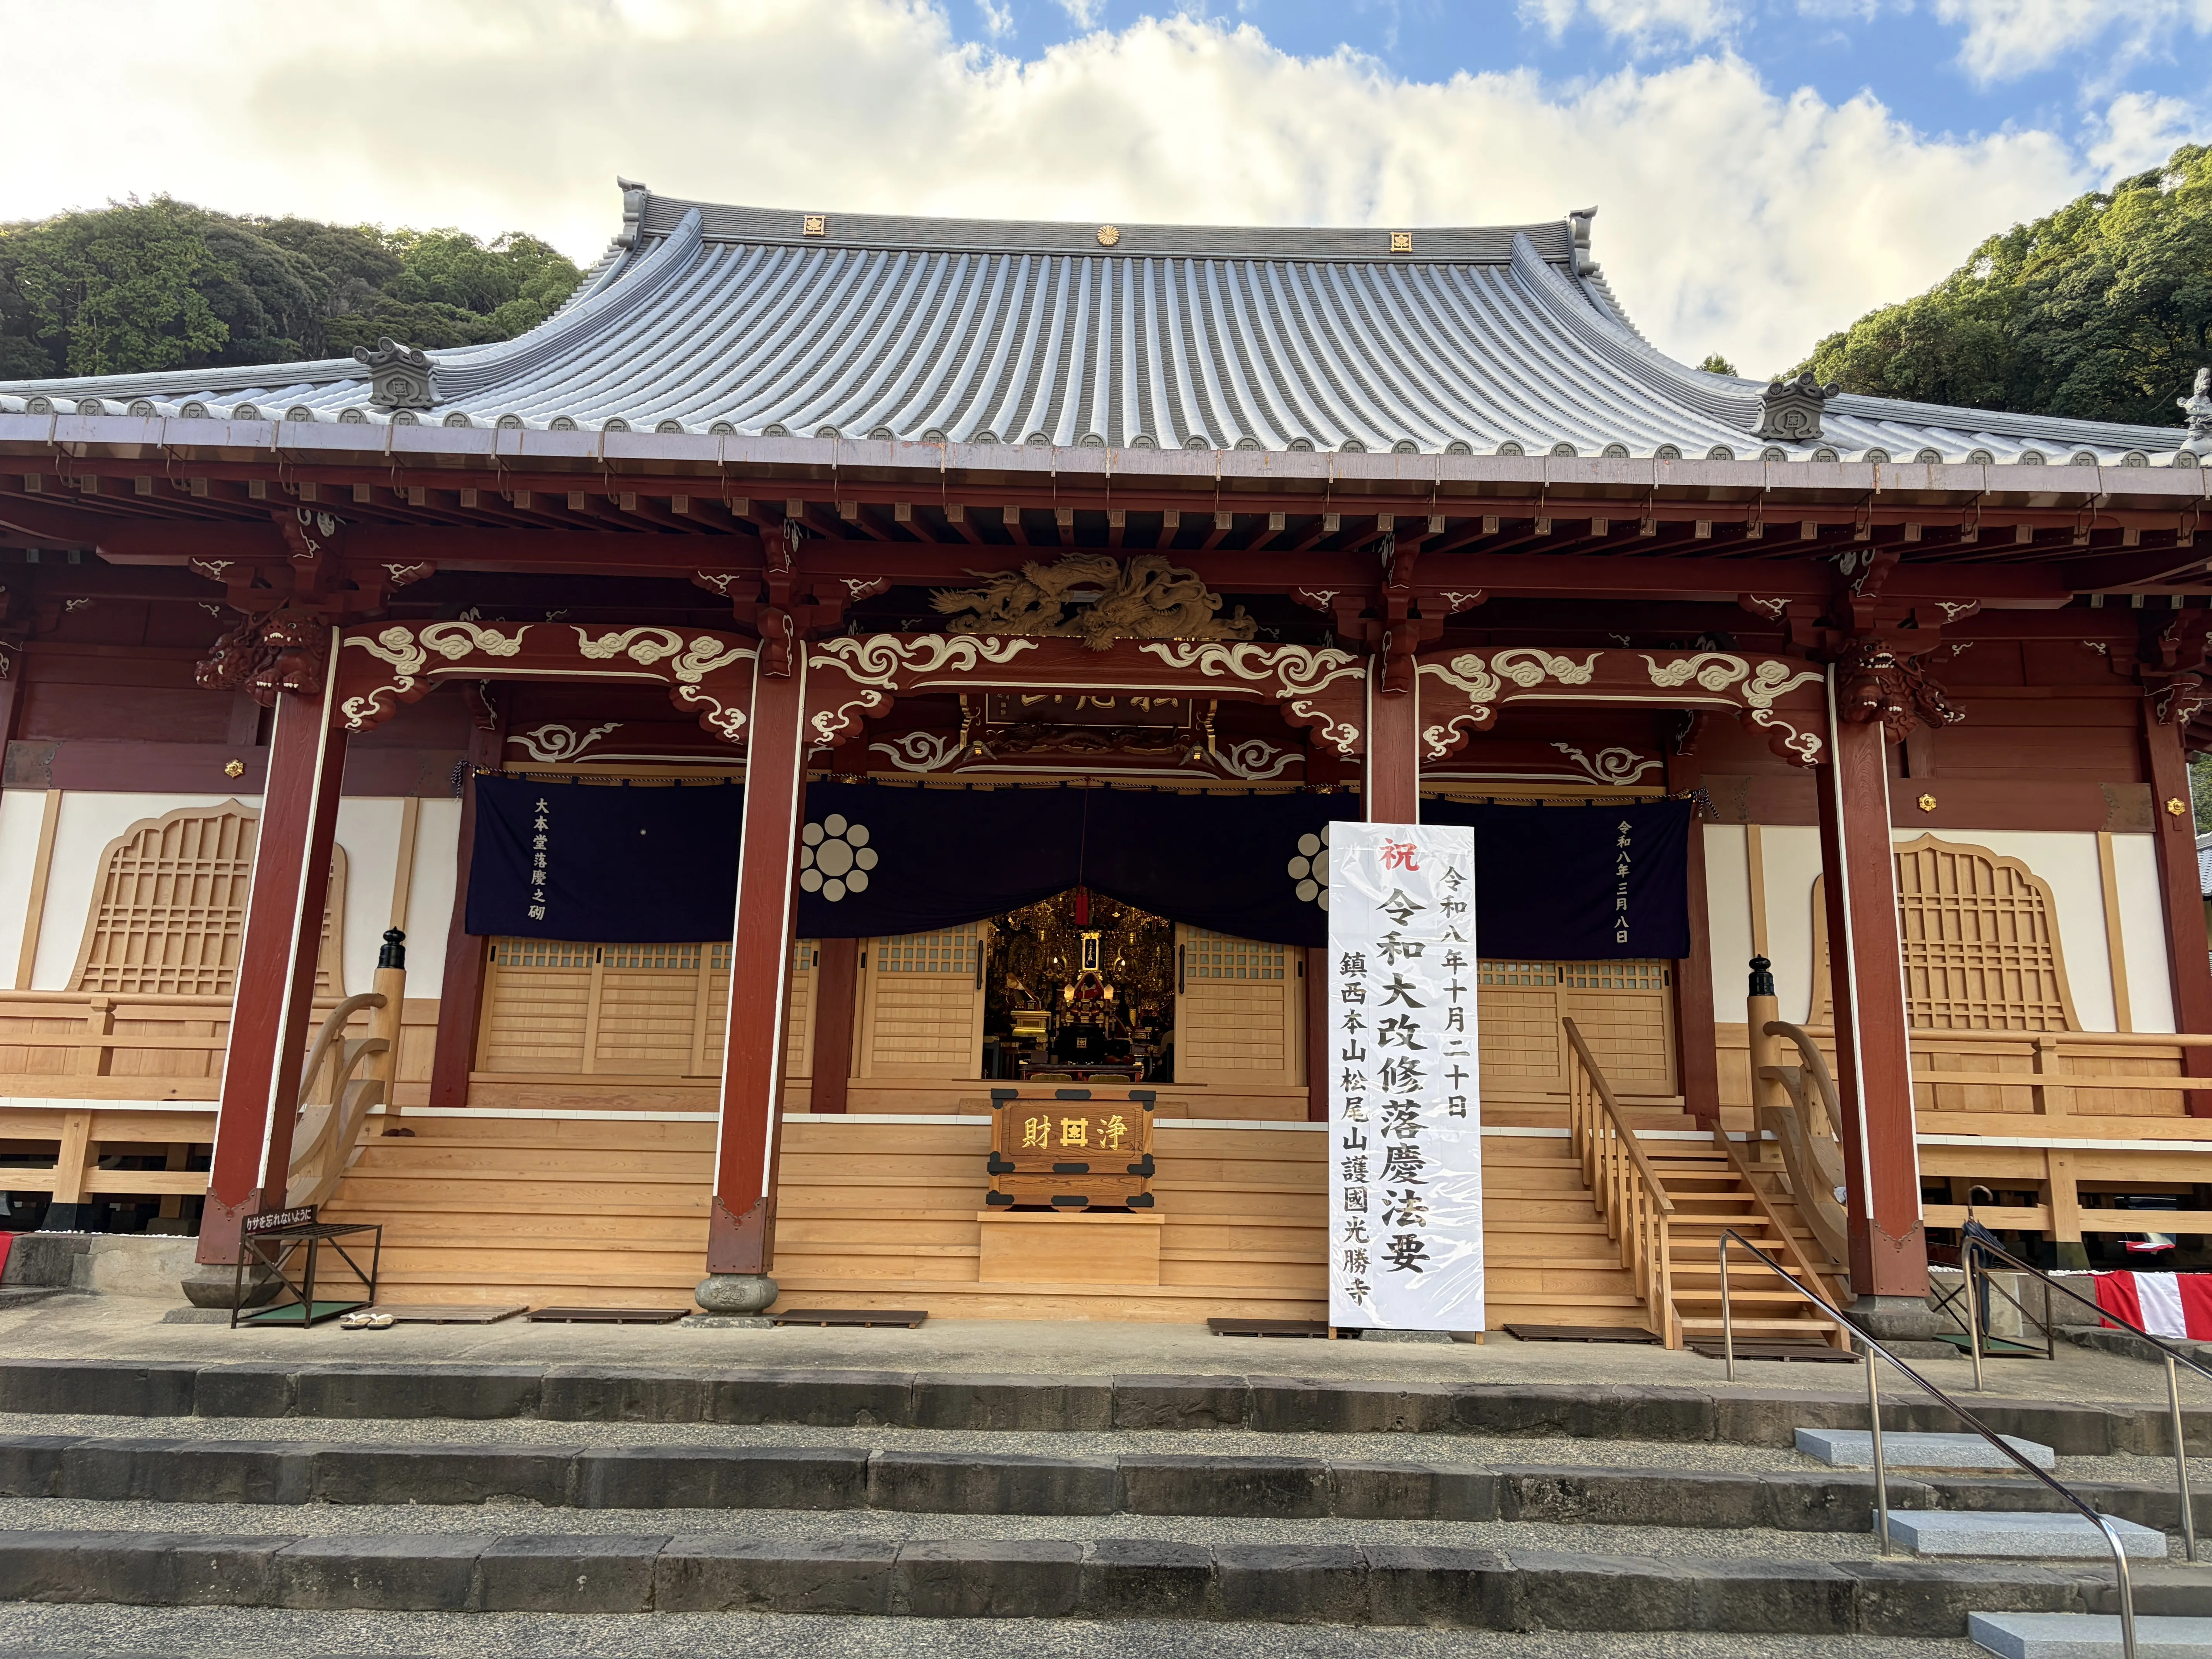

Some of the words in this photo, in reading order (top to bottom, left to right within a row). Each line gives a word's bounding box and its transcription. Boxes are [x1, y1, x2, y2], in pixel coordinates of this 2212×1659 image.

[528, 798, 550, 921] 大本堂落慶之砌
[1379, 838, 1420, 871] 祝
[1614, 821, 1632, 943] 令和八年三月八日
[1440, 866, 1470, 1119] 令和八年十月二十日
[1339, 951, 1371, 1306] 鎮西本山松尾山護國光勝寺
[1376, 888, 1430, 1274] 令和大改修落慶法要
[247, 1209, 311, 1230] カサを忘れないように
